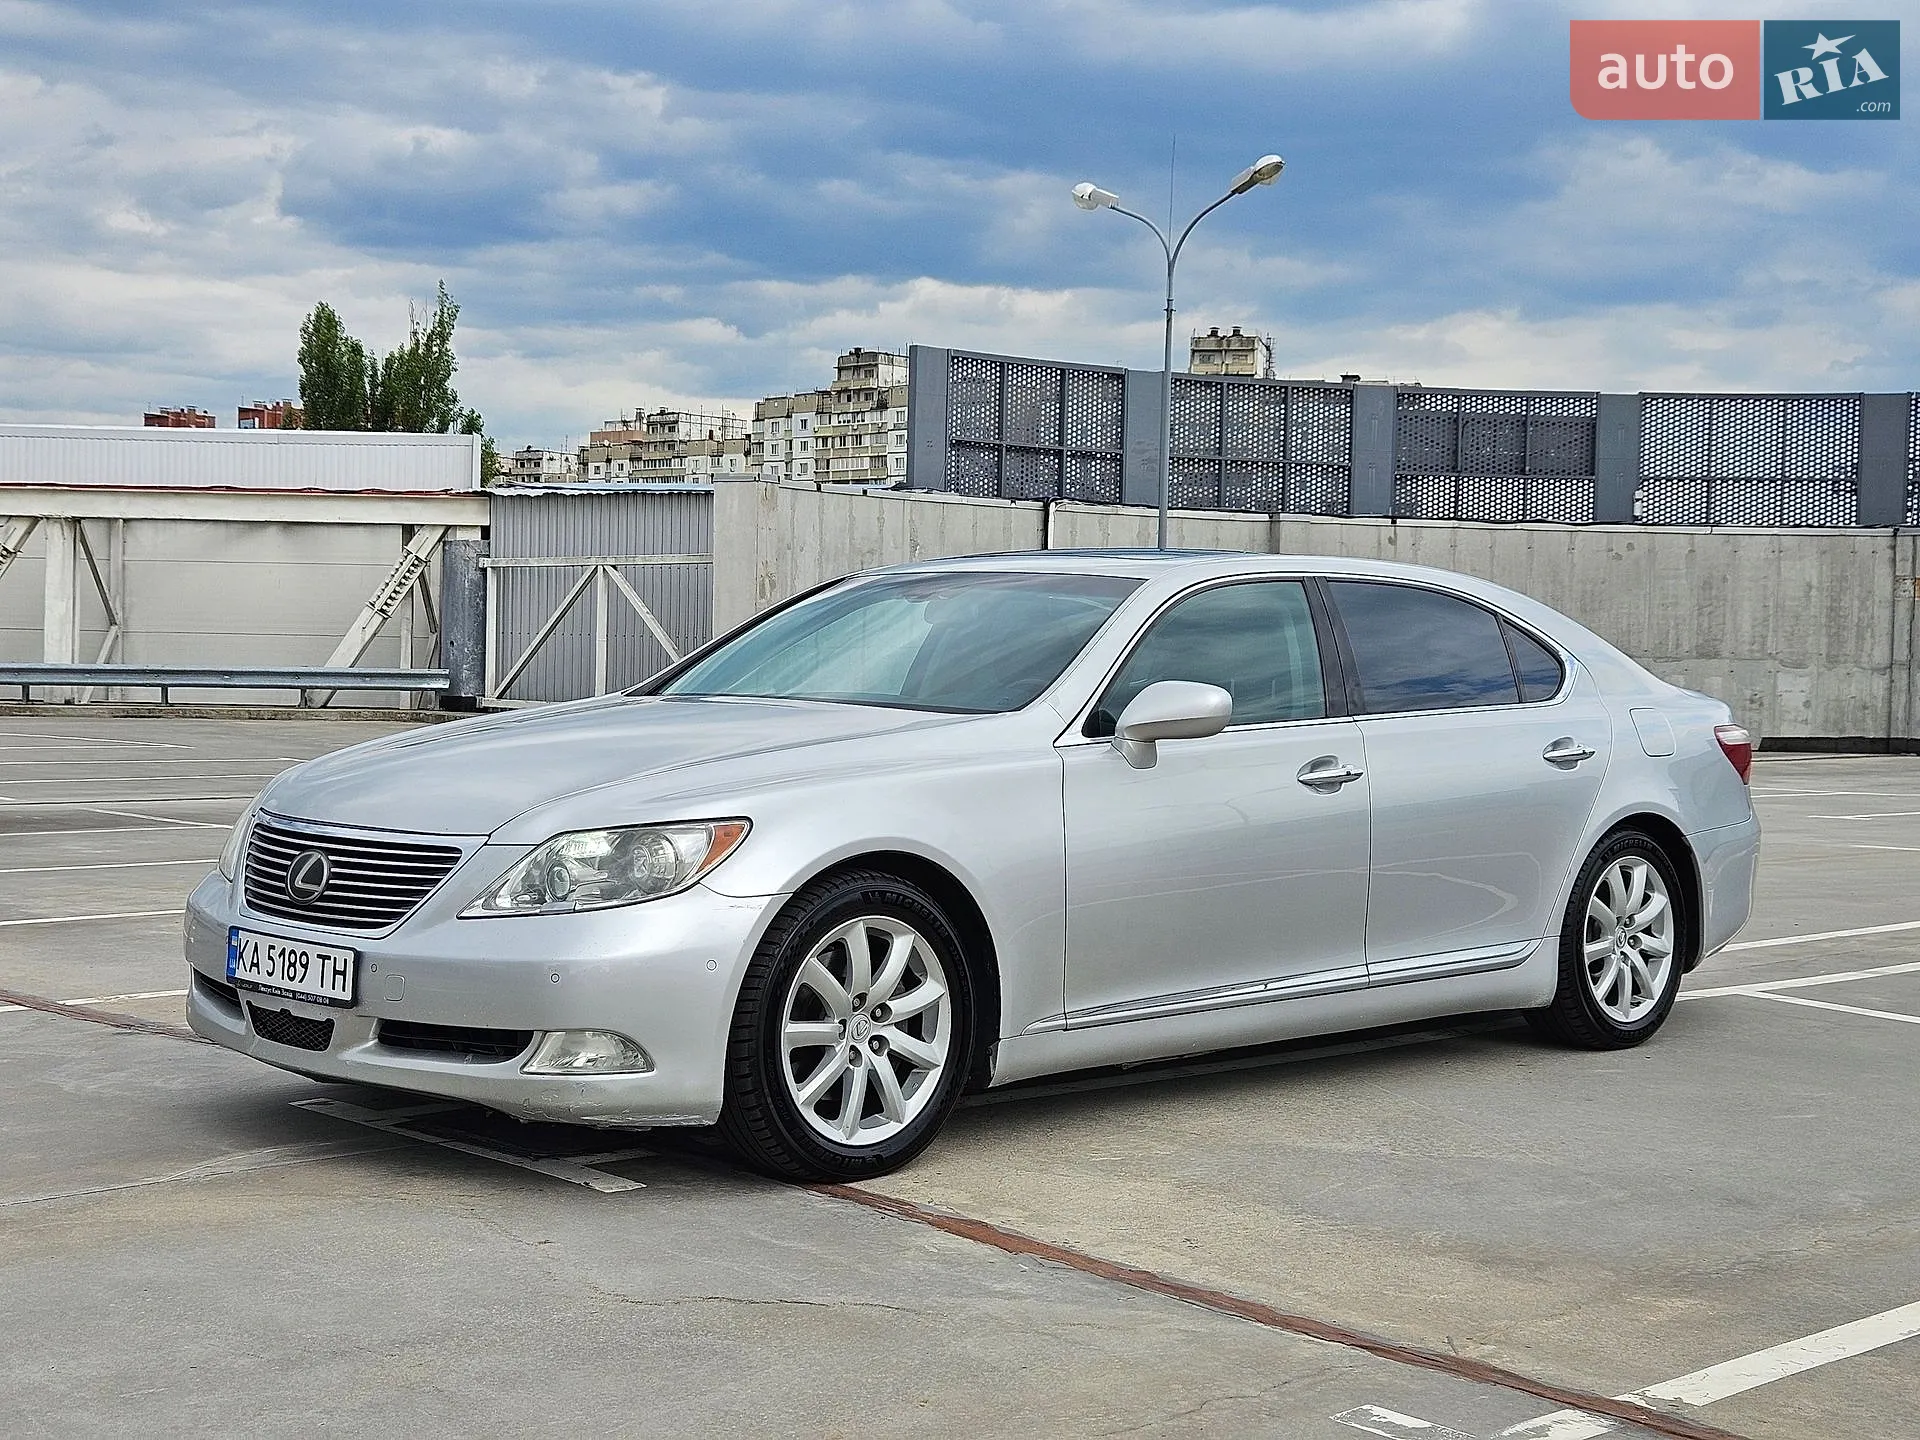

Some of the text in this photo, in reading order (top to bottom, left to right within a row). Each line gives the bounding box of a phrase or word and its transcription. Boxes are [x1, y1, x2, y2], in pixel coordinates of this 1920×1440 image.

[237, 937, 348, 993] KA 5189 TH
